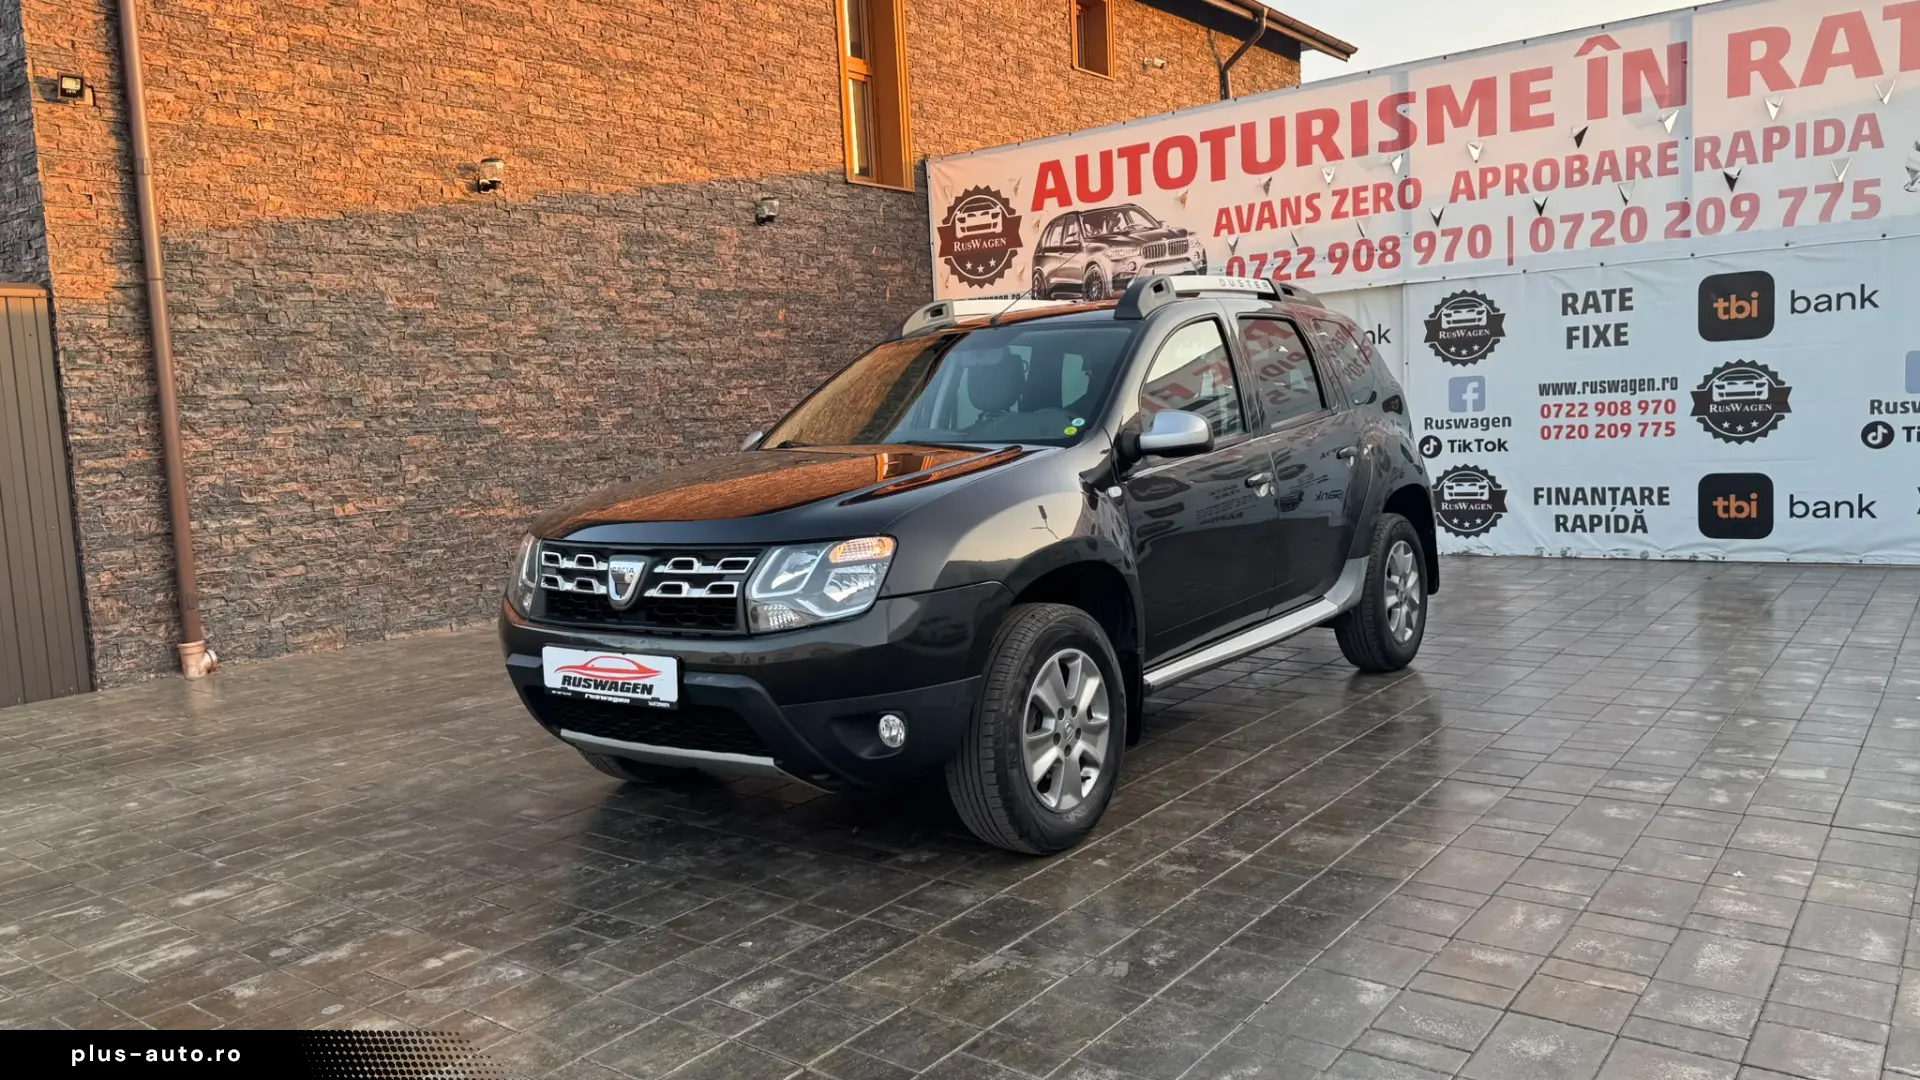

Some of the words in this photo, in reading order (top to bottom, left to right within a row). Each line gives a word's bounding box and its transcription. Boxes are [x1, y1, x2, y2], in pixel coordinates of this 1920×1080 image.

[1031, 66, 1555, 212] AUTOTURISME
[1574, 34, 1688, 120] ÎN
[1213, 191, 1321, 237] AVANS
[1331, 177, 1422, 220] ZERO
[1449, 140, 1680, 204] APROBARE
[1694, 113, 1885, 172] RAPIDA
[1226, 246, 1316, 281] 0722
[1328, 235, 1401, 275] 908
[1413, 223, 1493, 267] 970
[1529, 206, 1648, 253] 0720
[1664, 192, 1760, 238] 209
[1777, 178, 1882, 228] 775
[1218, 278, 1270, 291] DUSTER
[1561, 287, 1634, 316] RATE
[1712, 291, 1759, 320] tbi
[1789, 284, 1880, 314] bank
[1565, 322, 1630, 350] FIXE
[1538, 376, 1679, 397] www.ruswagen.ro
[1539, 402, 1589, 419] 0722
[1594, 400, 1632, 417] 908
[1637, 398, 1676, 415] 970
[1423, 415, 1512, 432] Ruswagen
[1539, 424, 1589, 440] 0720
[1594, 422, 1632, 439] 209
[1637, 420, 1676, 437] 775
[1447, 437, 1509, 453] TikTok
[1712, 492, 1758, 519] tbi
[1788, 493, 1877, 519] bank
[1554, 508, 1649, 533] RAPIDĂ
[561, 675, 654, 696] RUSWAGEN
